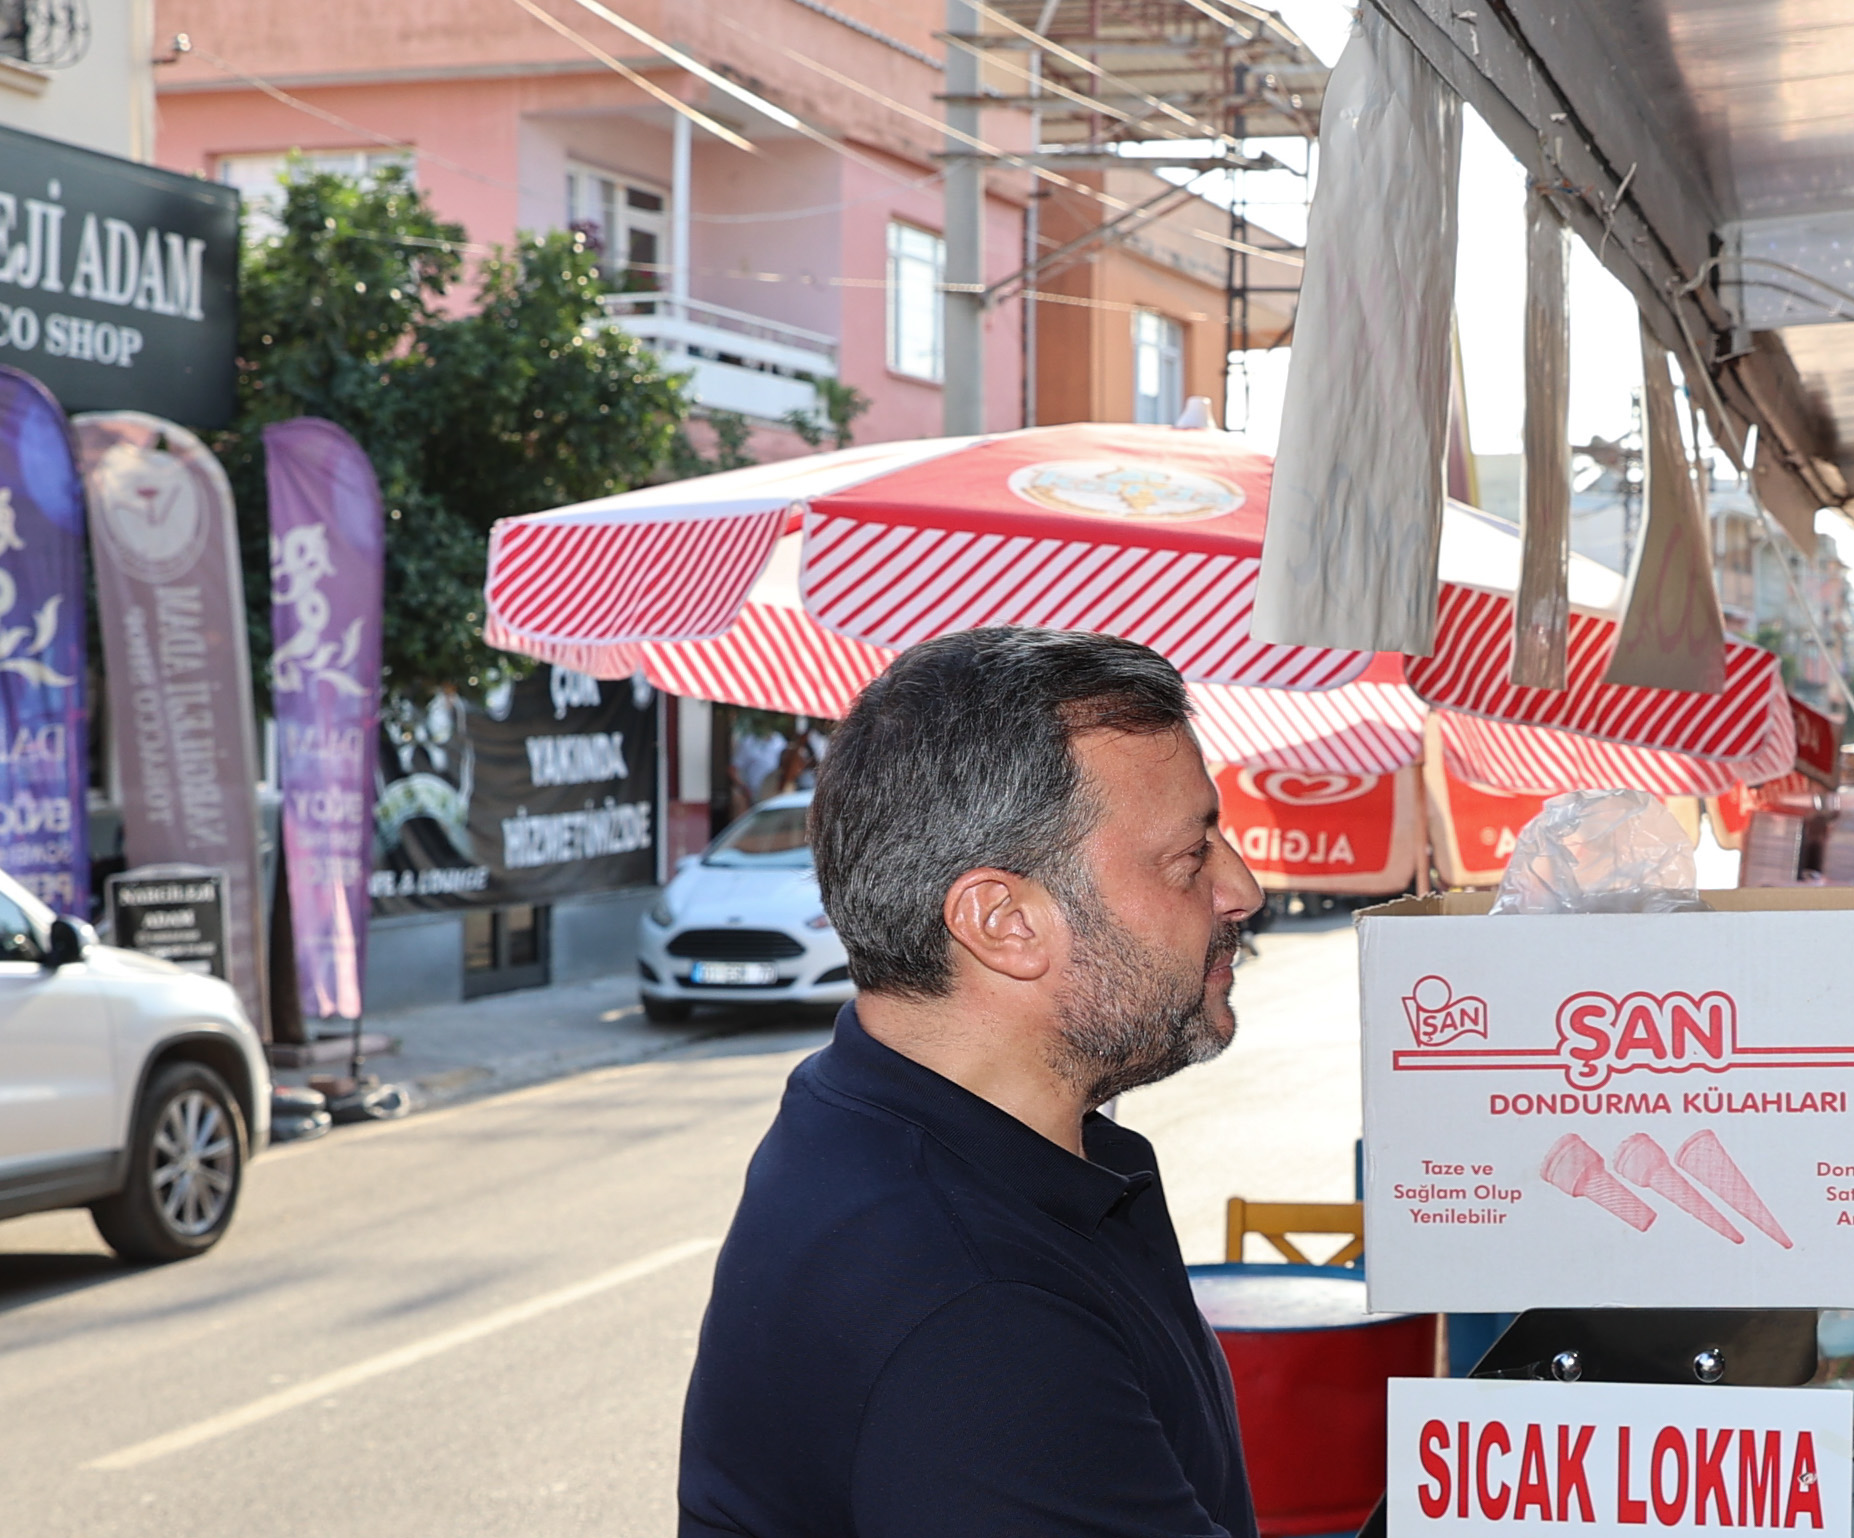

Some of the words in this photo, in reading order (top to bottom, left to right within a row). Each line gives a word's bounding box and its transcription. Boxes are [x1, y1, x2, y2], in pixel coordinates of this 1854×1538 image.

[69, 212, 206, 321] ADAM
[44, 313, 143, 367] SHOP
[525, 731, 628, 787] YAKINDA
[1421, 1006, 1481, 1043] ŞAN
[1568, 1003, 1725, 1078] ŞAN
[1489, 1092, 1672, 1116] DONDURMA
[1683, 1086, 1847, 1113] KÜLAHLARI
[1421, 1160, 1464, 1176] Taze
[1471, 1163, 1494, 1176] ve
[1394, 1183, 1467, 1205] Sağlam
[1473, 1183, 1522, 1205] Olup
[1410, 1208, 1507, 1225] Yenilebilir
[1418, 1419, 1596, 1522] SICAK
[1617, 1425, 1824, 1529] LOKMA
